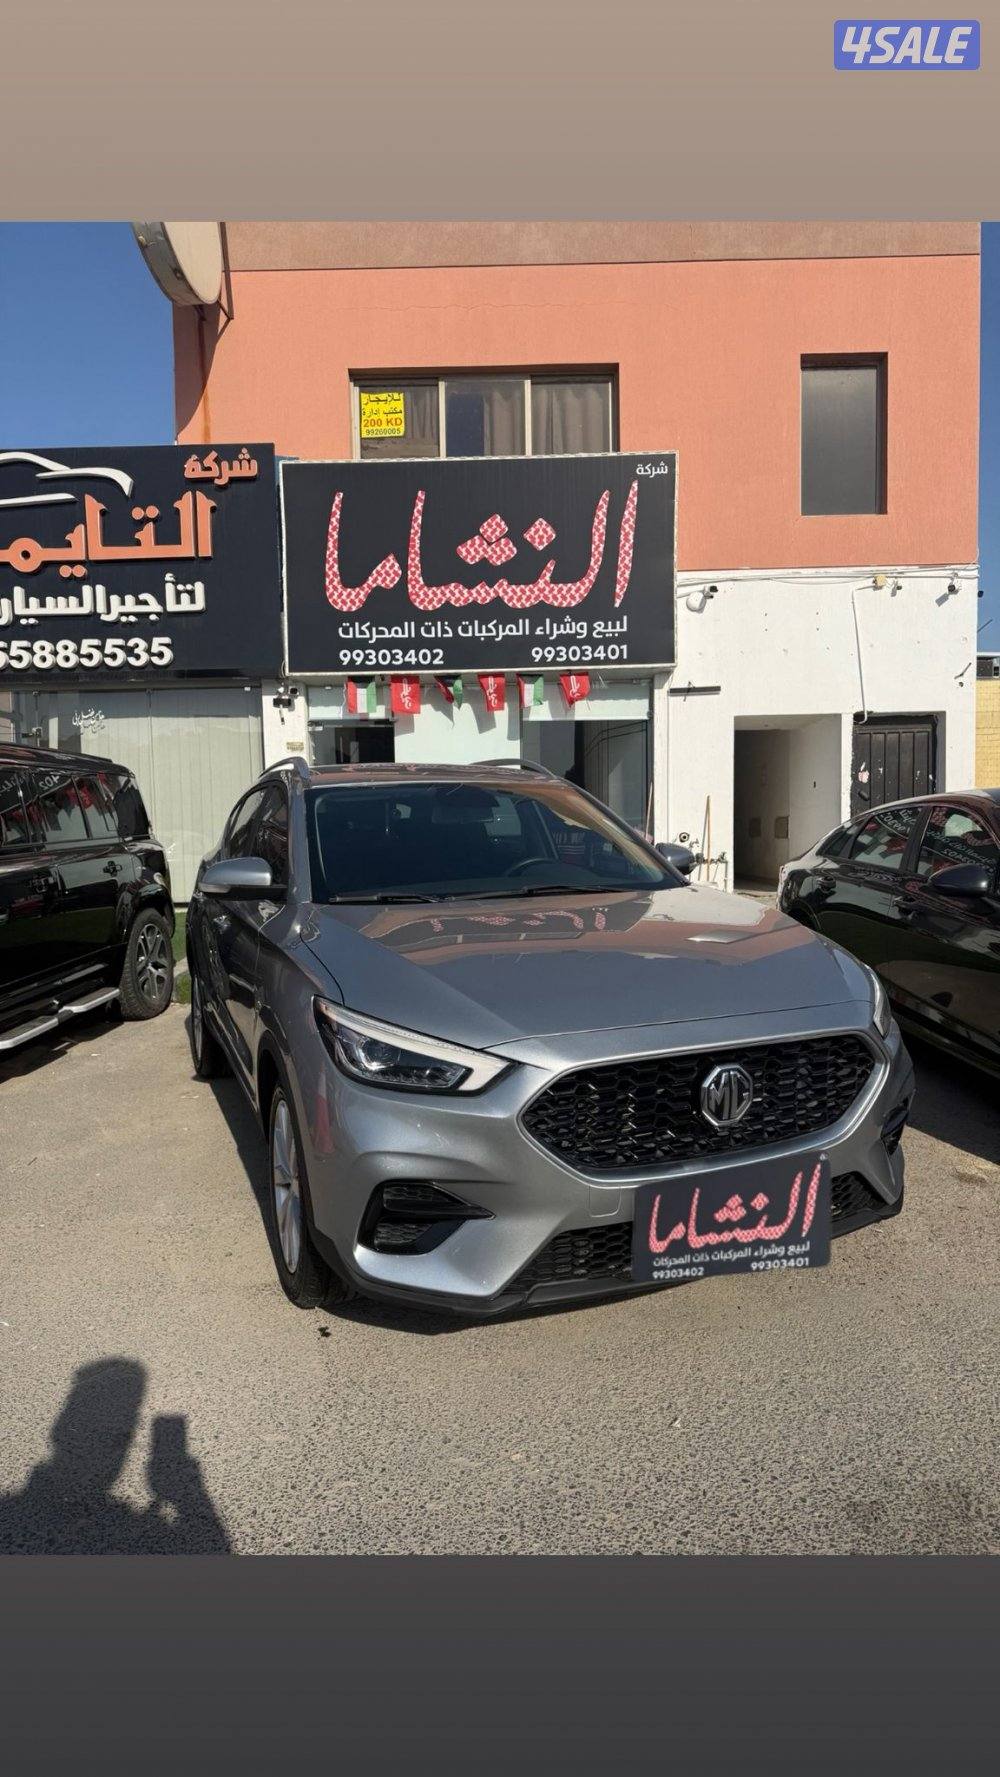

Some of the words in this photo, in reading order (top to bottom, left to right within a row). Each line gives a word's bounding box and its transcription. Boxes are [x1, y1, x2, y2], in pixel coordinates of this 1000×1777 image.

[363, 418, 382, 428] 200
[386, 417, 402, 426] KD
[184, 447, 258, 486] شركة
[636, 461, 668, 478] شركة
[325, 479, 638, 613] النشاما
[100, 573, 206, 622] لتأجير
[338, 622, 415, 643] المحركات
[421, 620, 453, 638] ذات
[458, 619, 529, 641] المركبات
[535, 616, 587, 638] وشراء
[593, 615, 628, 635] لبيع
[339, 648, 444, 666] 99303402
[531, 645, 628, 663] 99303401
[708, 1069, 750, 1121] MG
